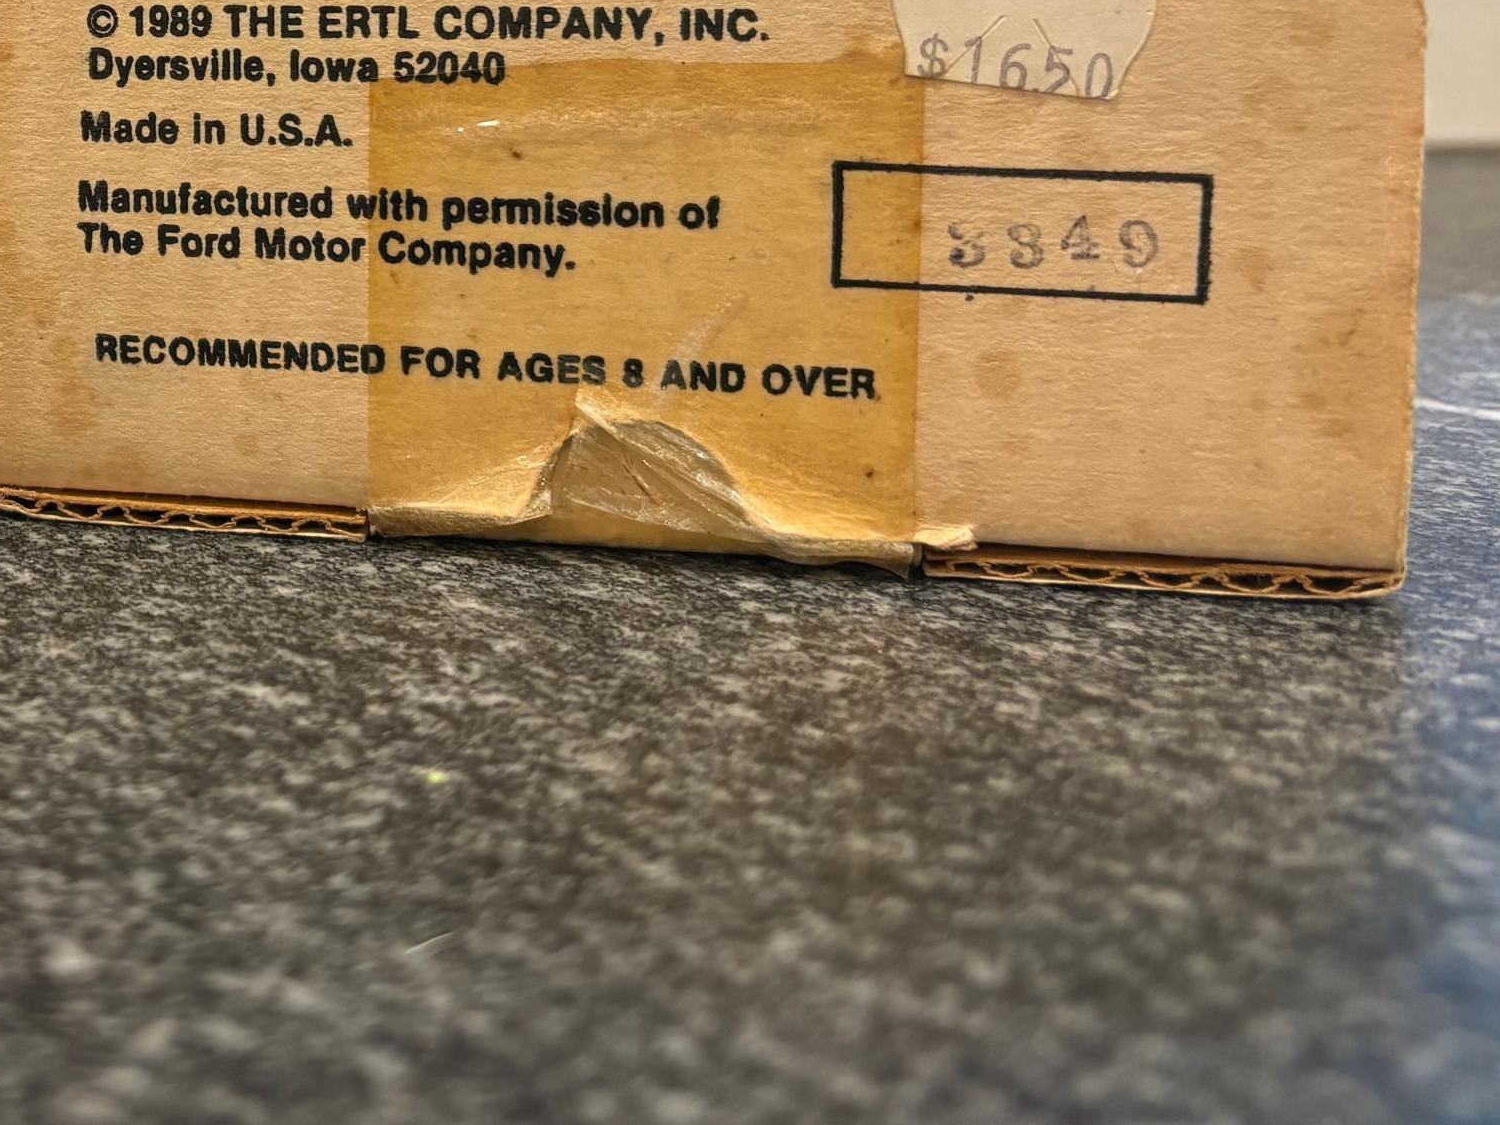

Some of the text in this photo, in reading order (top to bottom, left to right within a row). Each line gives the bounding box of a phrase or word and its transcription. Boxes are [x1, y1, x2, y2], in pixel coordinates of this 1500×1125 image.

[129, 5, 212, 38] 1989
[223, 5, 305, 38] THE
[318, 5, 420, 39] ERTL
[434, 5, 665, 46] COMPANY,
[680, 8, 770, 42] INC.
[87, 47, 506, 87] Dyersville, Iowa 52040
[81, 110, 353, 147] Made in U.S.A.
[77, 180, 721, 231] Manufactured with permission of
[77, 221, 576, 277] The Ford Motor Company.
[94, 333, 386, 375] RECOMMENDED
[400, 345, 481, 379] FOR
[497, 351, 607, 386] AGES
[622, 358, 644, 388] 8
[660, 359, 746, 393] AND
